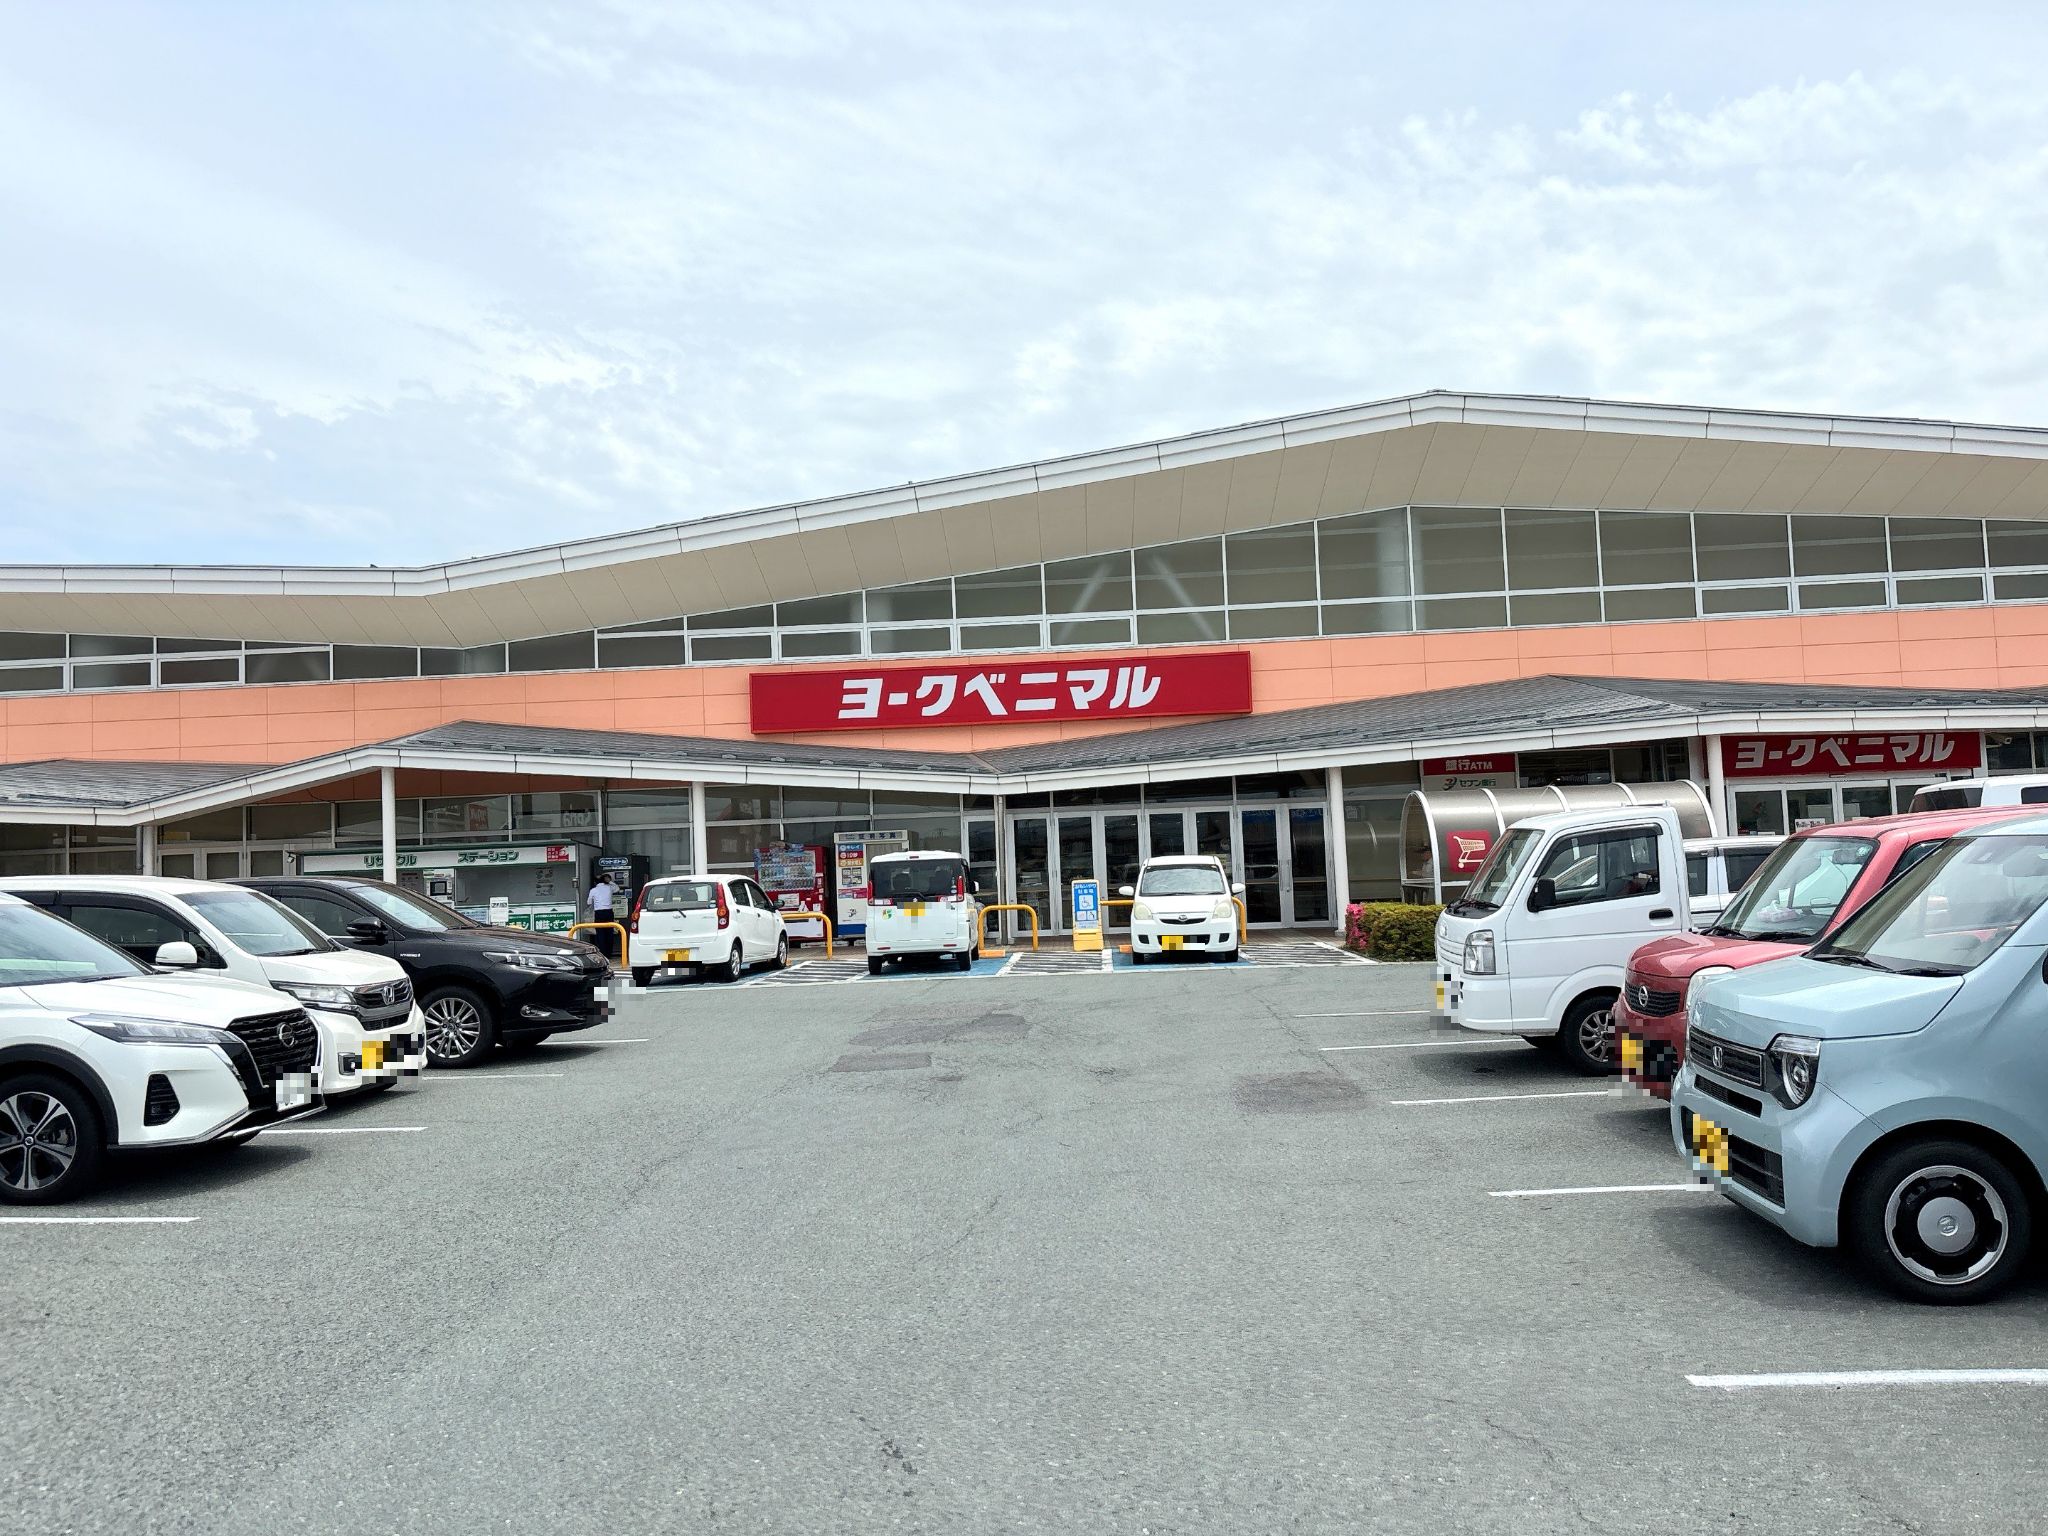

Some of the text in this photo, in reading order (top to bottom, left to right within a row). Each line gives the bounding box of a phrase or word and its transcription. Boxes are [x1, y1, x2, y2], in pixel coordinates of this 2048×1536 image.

[838, 666, 1161, 719] ヨークベニマル
[1735, 733, 1955, 769] ヨークベニマル
[1446, 759, 1493, 771] 銀行ATM
[1459, 778, 1496, 787] セブン銀行
[364, 854, 417, 867] リサクル
[458, 850, 519, 863] ステーション
